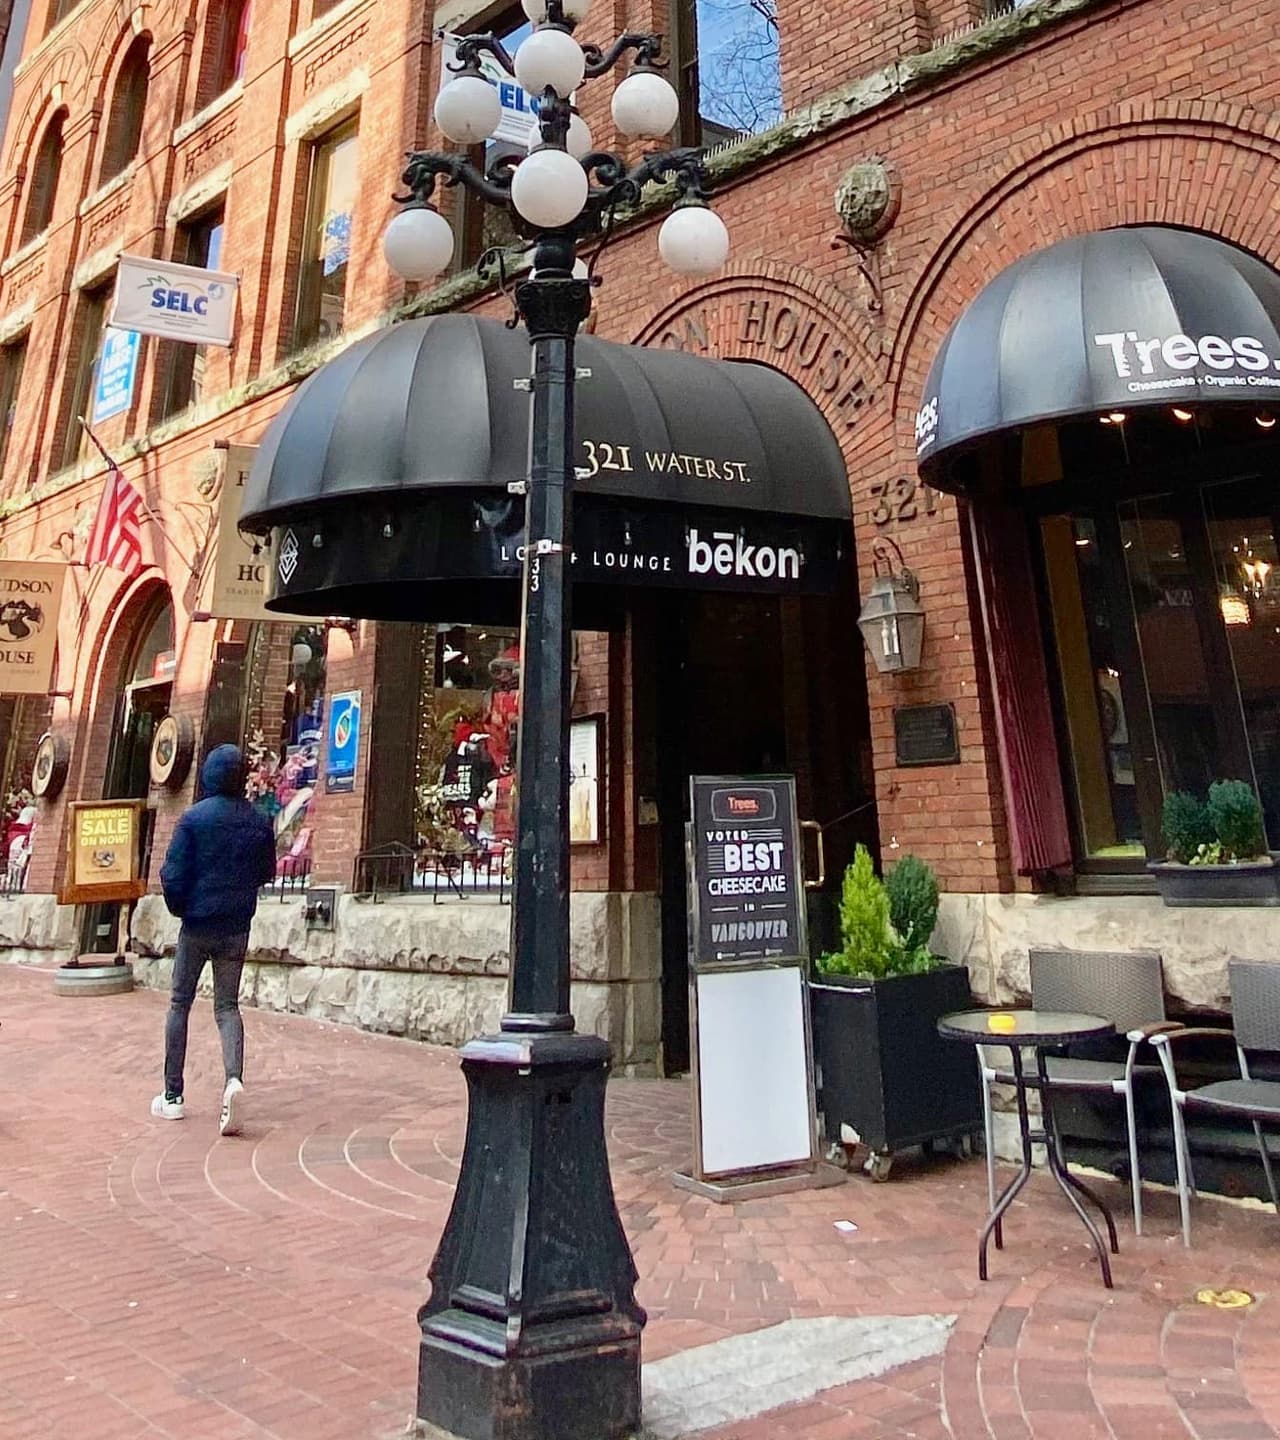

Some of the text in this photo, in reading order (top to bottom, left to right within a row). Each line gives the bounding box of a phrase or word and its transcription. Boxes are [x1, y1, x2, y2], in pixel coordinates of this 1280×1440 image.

[151, 287, 208, 316] SELC
[739, 299, 876, 428] HOUSE
[1127, 375, 1196, 392] Cheesecake
[1204, 373, 1246, 390] Organic
[582, 440, 752, 483] 321 WATER ST.
[871, 474, 937, 526] 321
[593, 551, 671, 572] LOUNGE
[82, 808, 131, 819] BLOWOUT
[81, 818, 129, 836] SALE
[706, 830, 749, 842] VOTED
[80, 834, 129, 846] ON NOW!
[723, 842, 785, 873] BEST
[707, 875, 787, 896] CHEESECAKE
[711, 919, 789, 943] VANCOUVER
